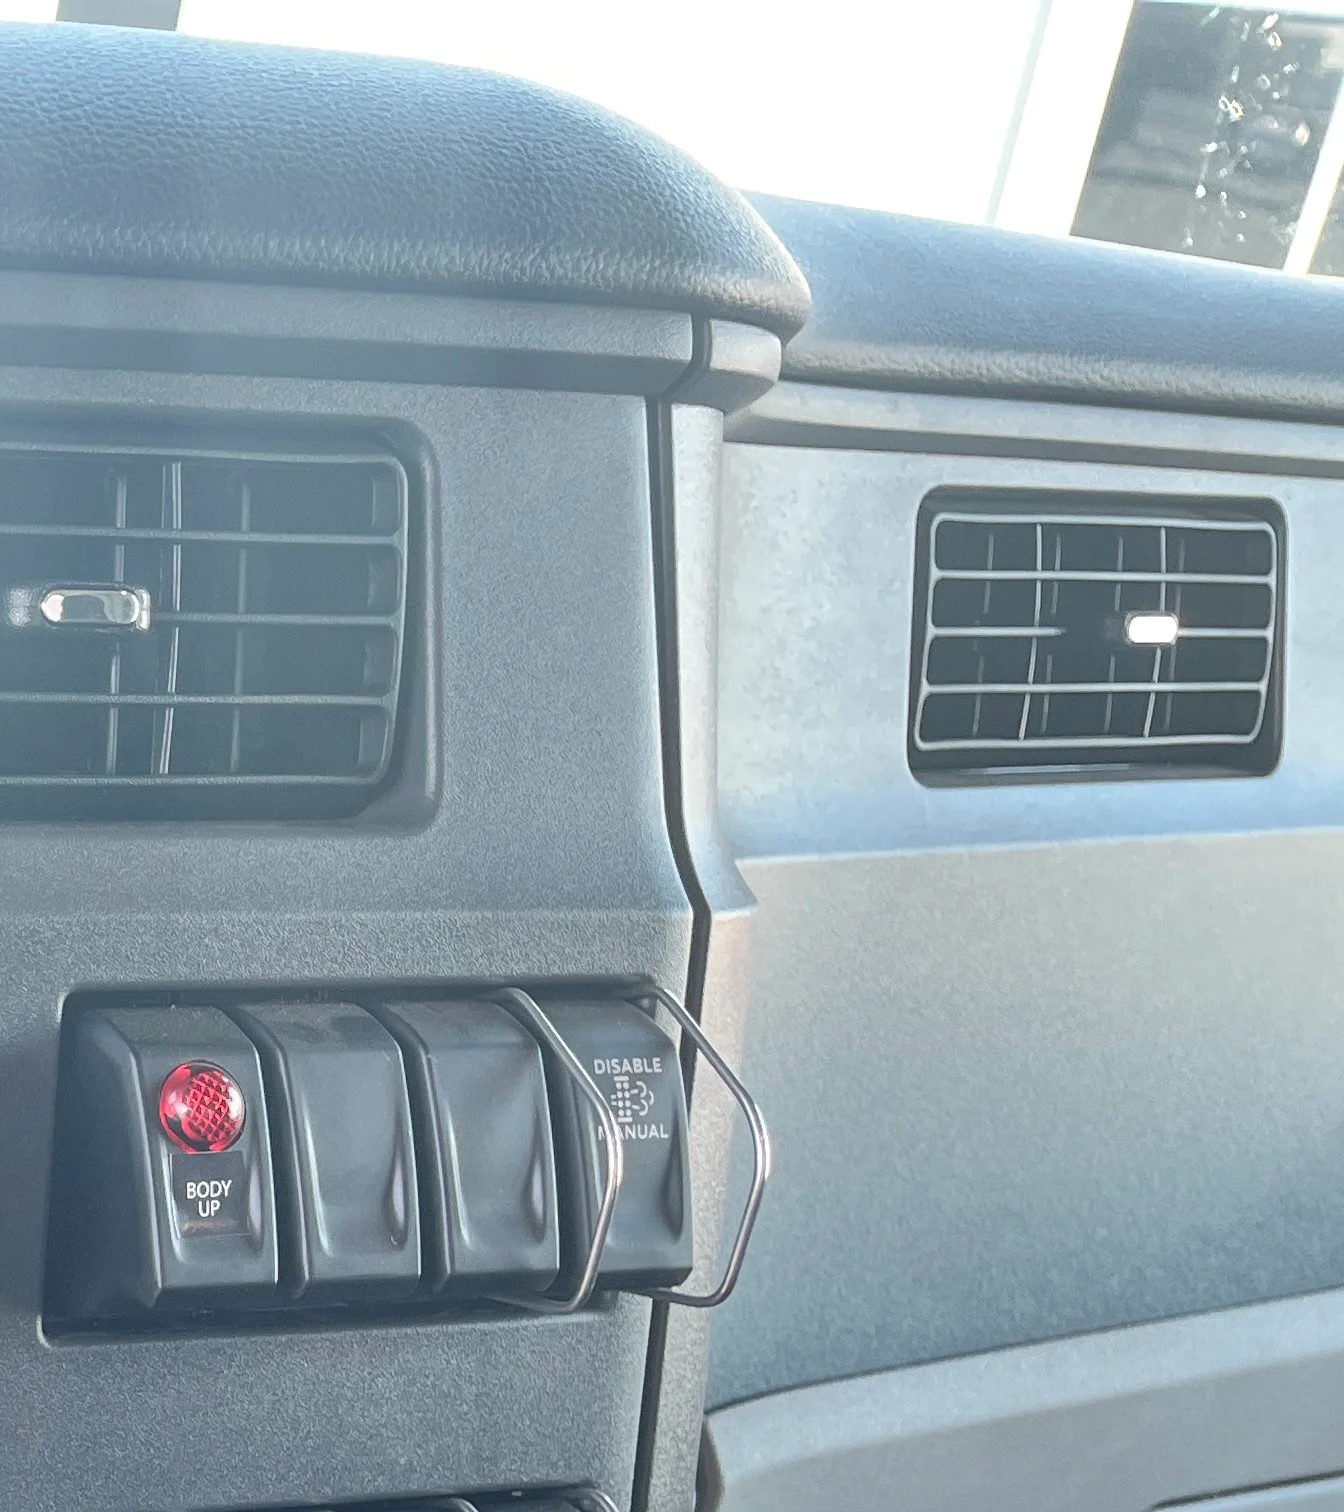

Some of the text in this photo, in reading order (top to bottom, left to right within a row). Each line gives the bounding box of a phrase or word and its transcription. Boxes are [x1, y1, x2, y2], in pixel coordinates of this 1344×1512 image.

[593, 1057, 663, 1075] DISABLE
[186, 1178, 233, 1199] BODY
[198, 1199, 221, 1218] UP
